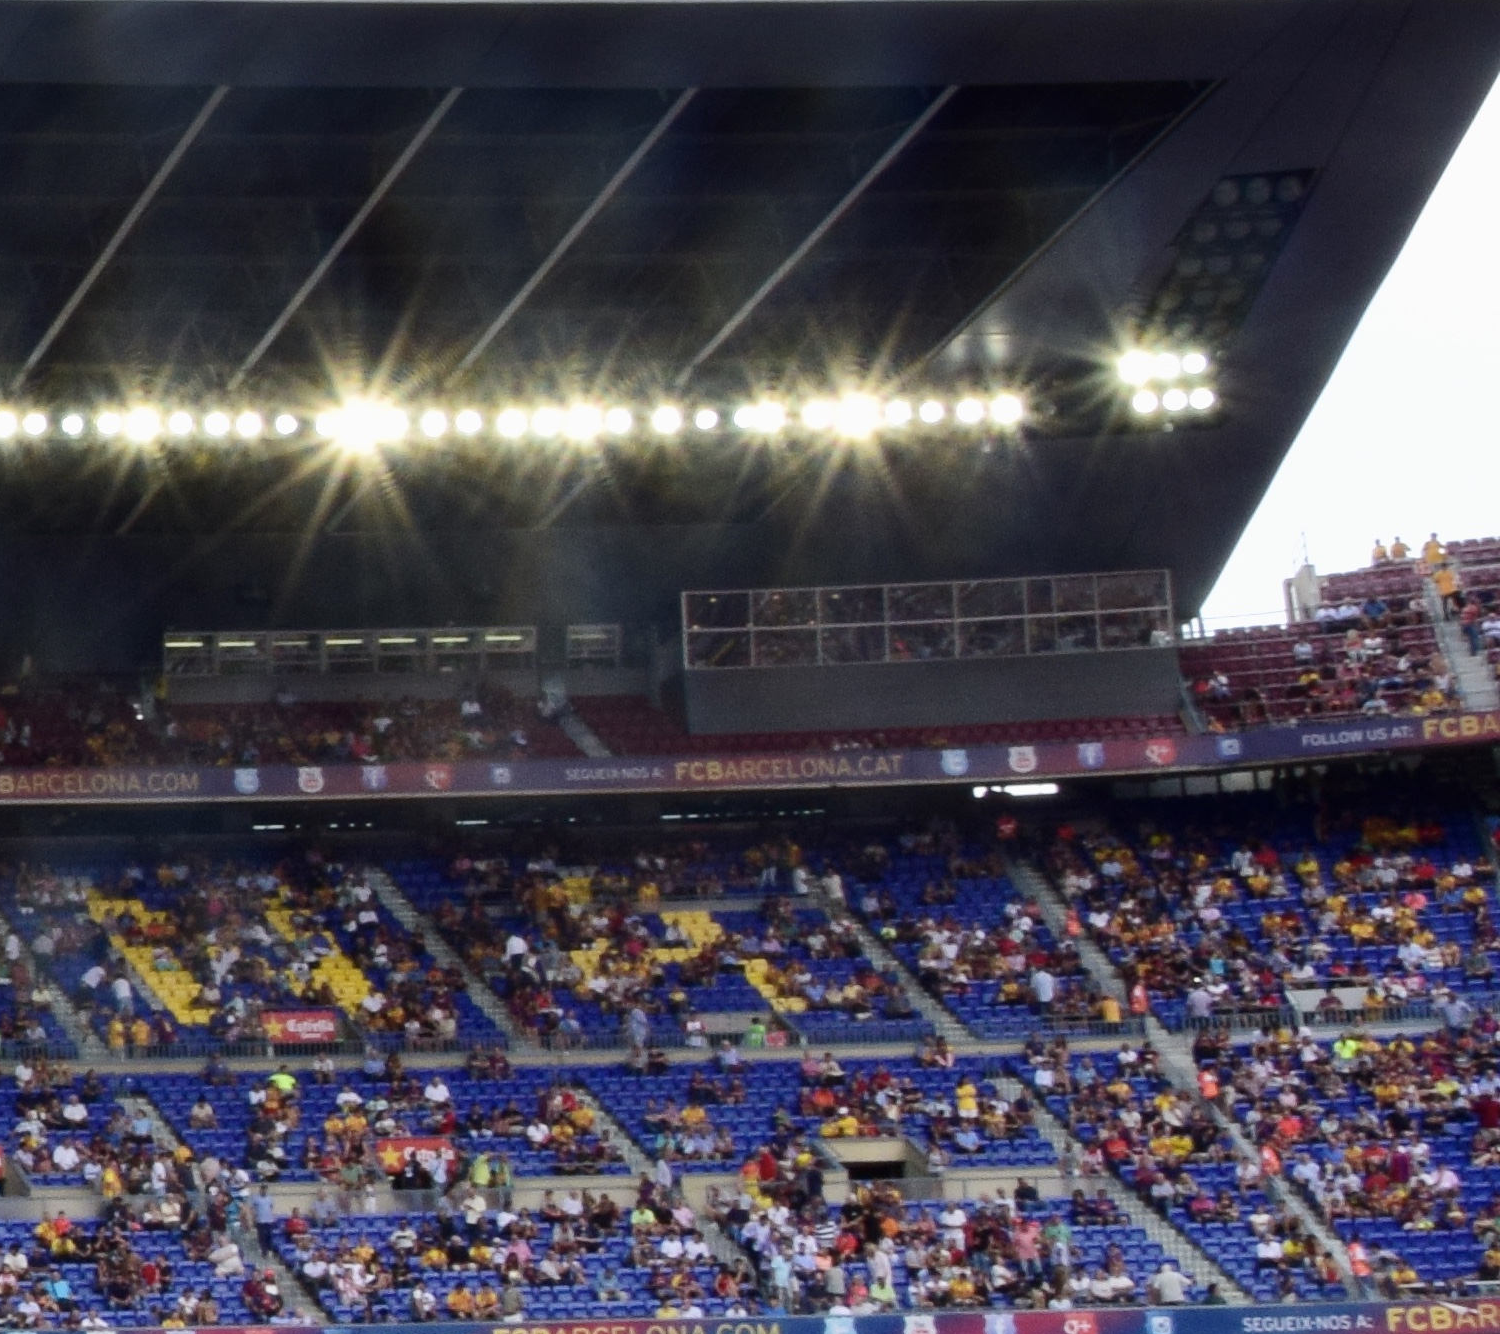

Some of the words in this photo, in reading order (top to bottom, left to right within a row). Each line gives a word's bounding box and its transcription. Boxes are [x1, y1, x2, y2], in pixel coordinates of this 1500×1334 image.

[1302, 730, 1363, 747] FOLLOW
[1366, 727, 1388, 742] US
[675, 754, 904, 782] FCBARCELONA.CAT
[1242, 1312, 1351, 1334] SEGUEIX-NOS
